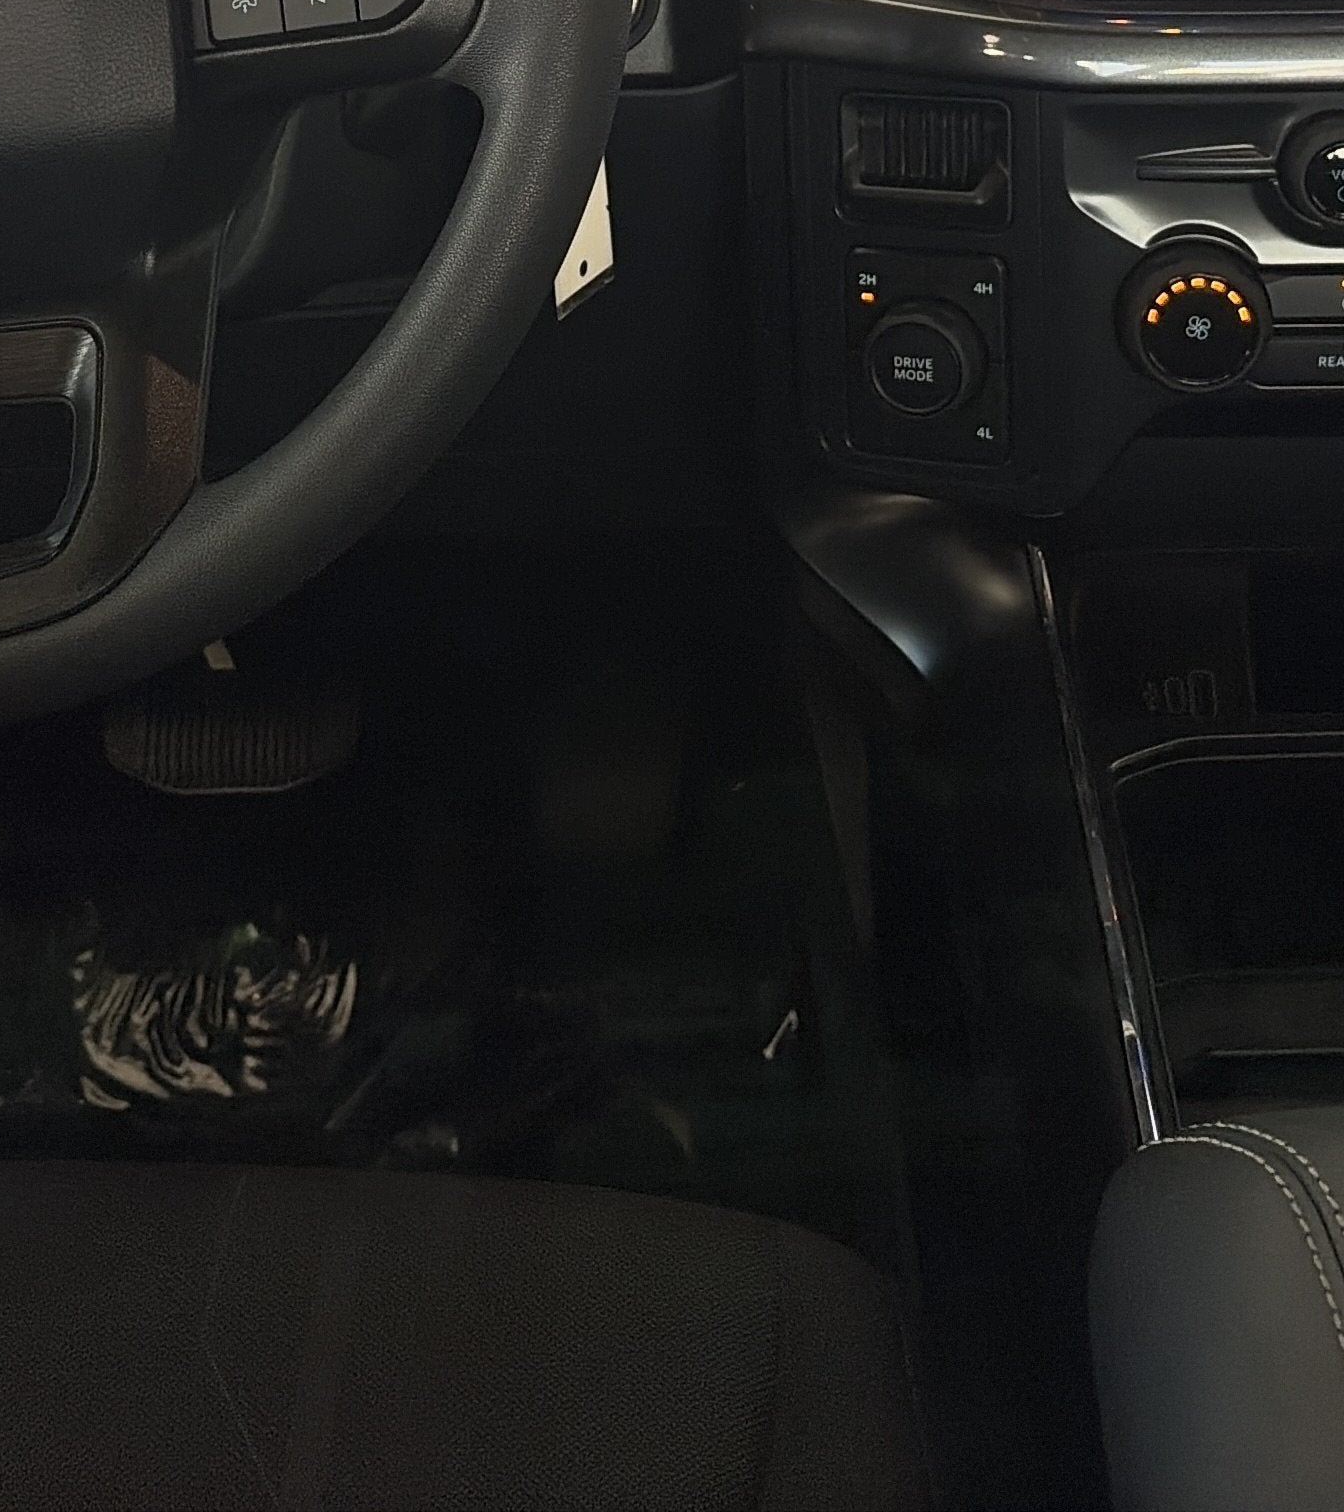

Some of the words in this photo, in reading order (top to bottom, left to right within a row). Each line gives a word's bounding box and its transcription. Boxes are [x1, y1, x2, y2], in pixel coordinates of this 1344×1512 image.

[858, 273, 878, 286] 2H
[973, 281, 994, 295] 4H
[893, 355, 935, 371] DRIVE
[893, 369, 935, 384] MODE
[975, 426, 994, 440] 4L
